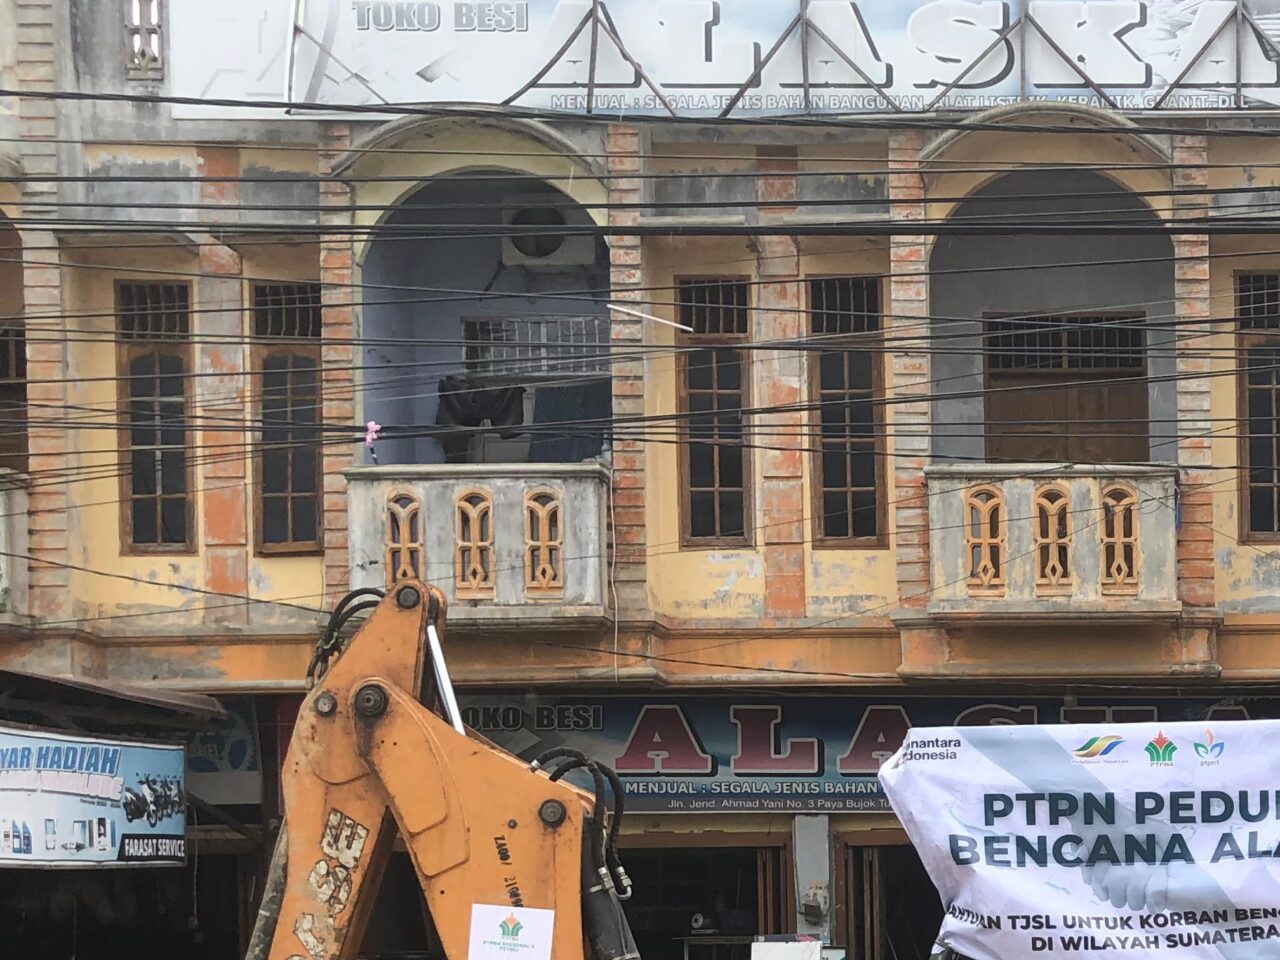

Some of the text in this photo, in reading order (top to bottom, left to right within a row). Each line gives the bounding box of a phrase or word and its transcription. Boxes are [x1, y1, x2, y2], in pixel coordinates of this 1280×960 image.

[351, 1, 529, 32] TOKO BESI
[551, 95, 629, 109] MENJUAL
[644, 95, 709, 109] SEGALA
[712, 95, 763, 109] JENIS
[767, 95, 824, 109] BAHAN
[460, 705, 603, 732] OKO BESI
[36, 746, 120, 776] HADIAH
[625, 782, 697, 794] MENJUAL
[711, 782, 771, 794] SEGALA
[774, 782, 820, 794] JENIS
[825, 782, 878, 794] BAHAN
[721, 799, 760, 809] Ahmad
[762, 799, 784, 809] Yani
[807, 799, 815, 808] 3
[817, 799, 843, 810] Paya
[846, 799, 876, 811] Bujok
[983, 791, 1116, 827] PTPN
[124, 838, 185, 857] FARASAT SERVICE
[948, 831, 1195, 868] BENCANA
[949, 903, 1002, 930] ANTUAN
[1007, 914, 1057, 930] TJSL
[1063, 914, 1134, 930] UNTUK
[1139, 908, 1229, 929] KORBAN
[1031, 923, 1280, 951] DI WILAYAH SUMATERA
